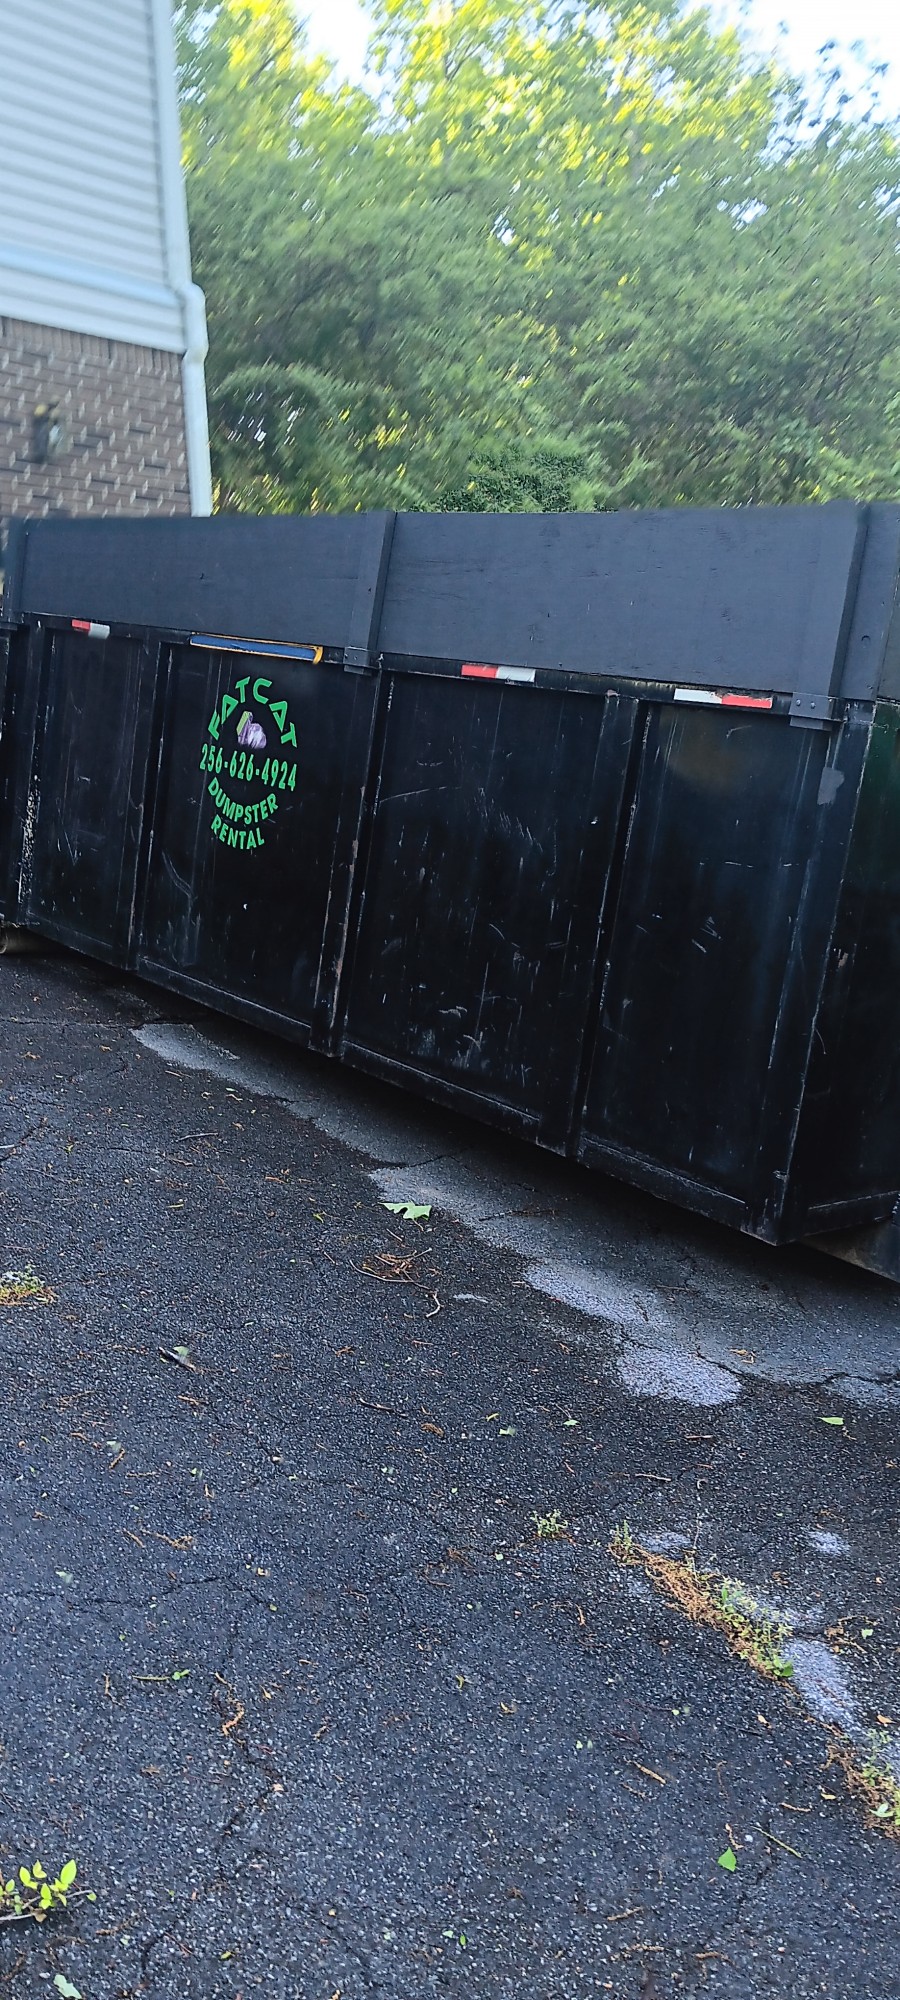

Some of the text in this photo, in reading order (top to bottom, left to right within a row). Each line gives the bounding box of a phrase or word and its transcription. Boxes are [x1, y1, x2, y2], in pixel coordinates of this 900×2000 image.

[200, 743, 297, 791] 256-626-4924
[207, 777, 278, 825] DUMPSTER
[211, 814, 265, 850] RENTAL
